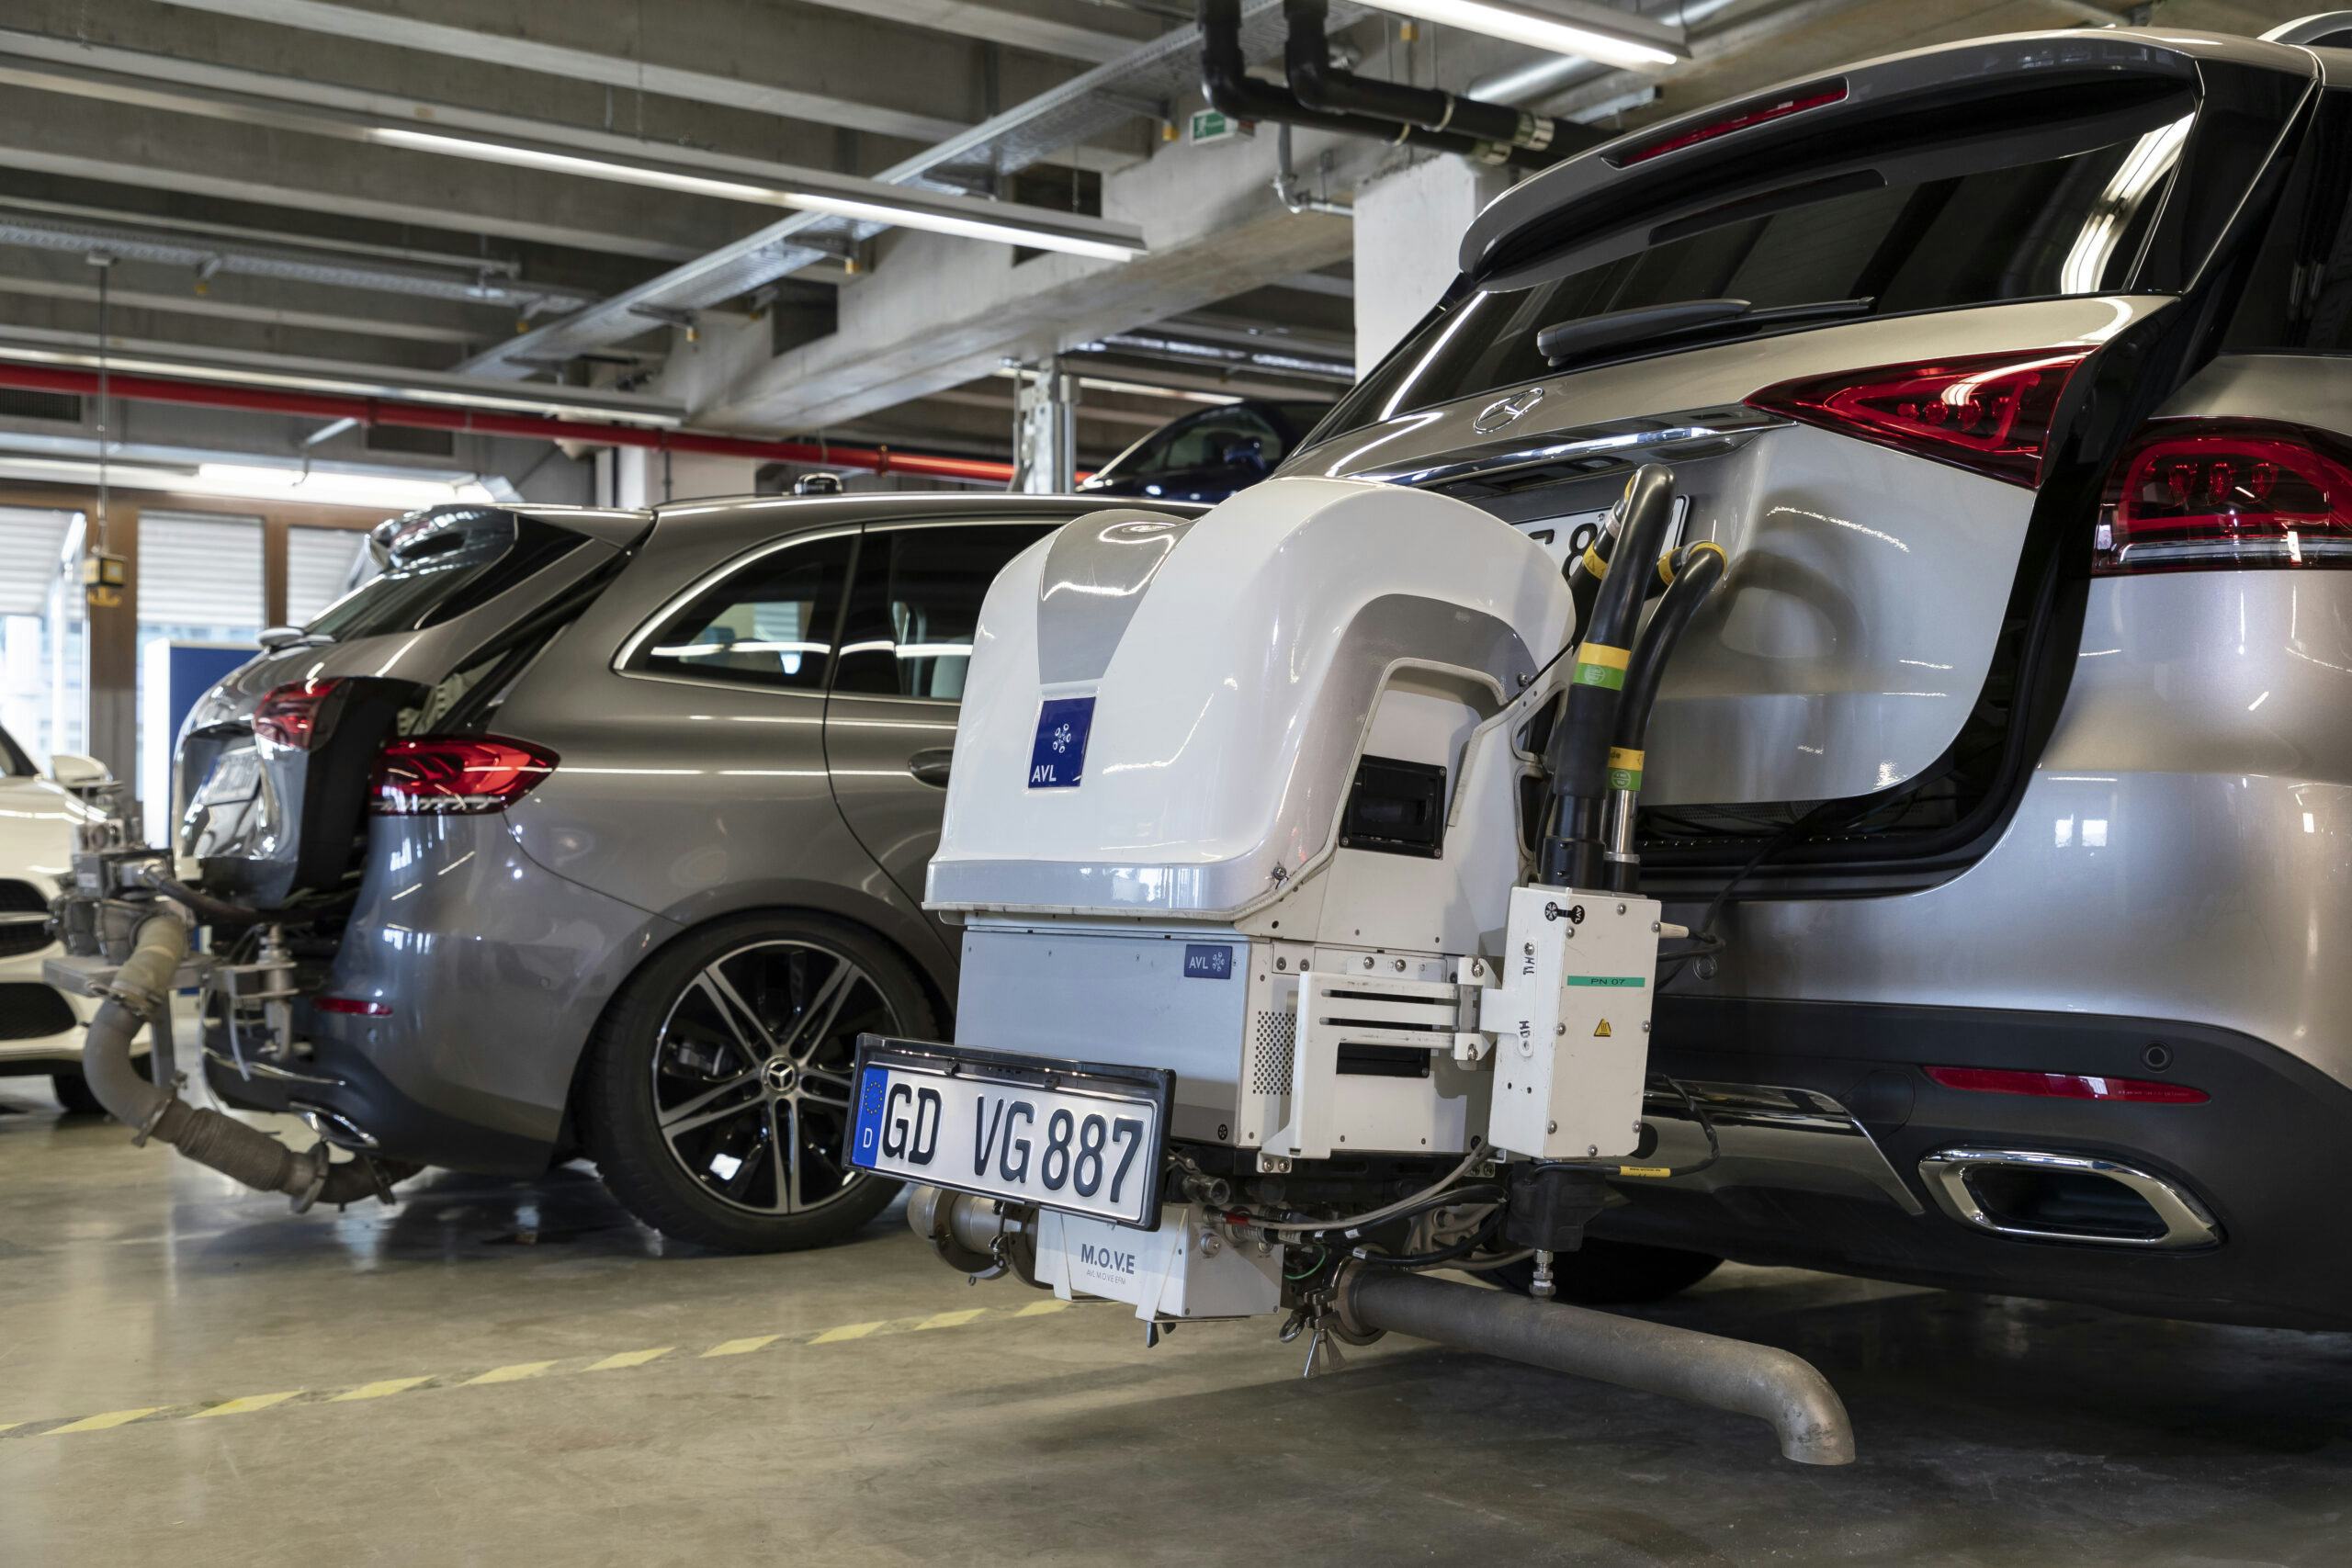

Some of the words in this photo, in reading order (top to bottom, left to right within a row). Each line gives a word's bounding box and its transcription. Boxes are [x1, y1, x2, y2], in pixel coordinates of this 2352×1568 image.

[1031, 764, 1057, 783] AVL
[1189, 956, 1208, 970] AVL
[882, 1082, 943, 1166] GD
[862, 1127, 873, 1149] D
[1080, 1243, 1136, 1275] M.O.V.E
